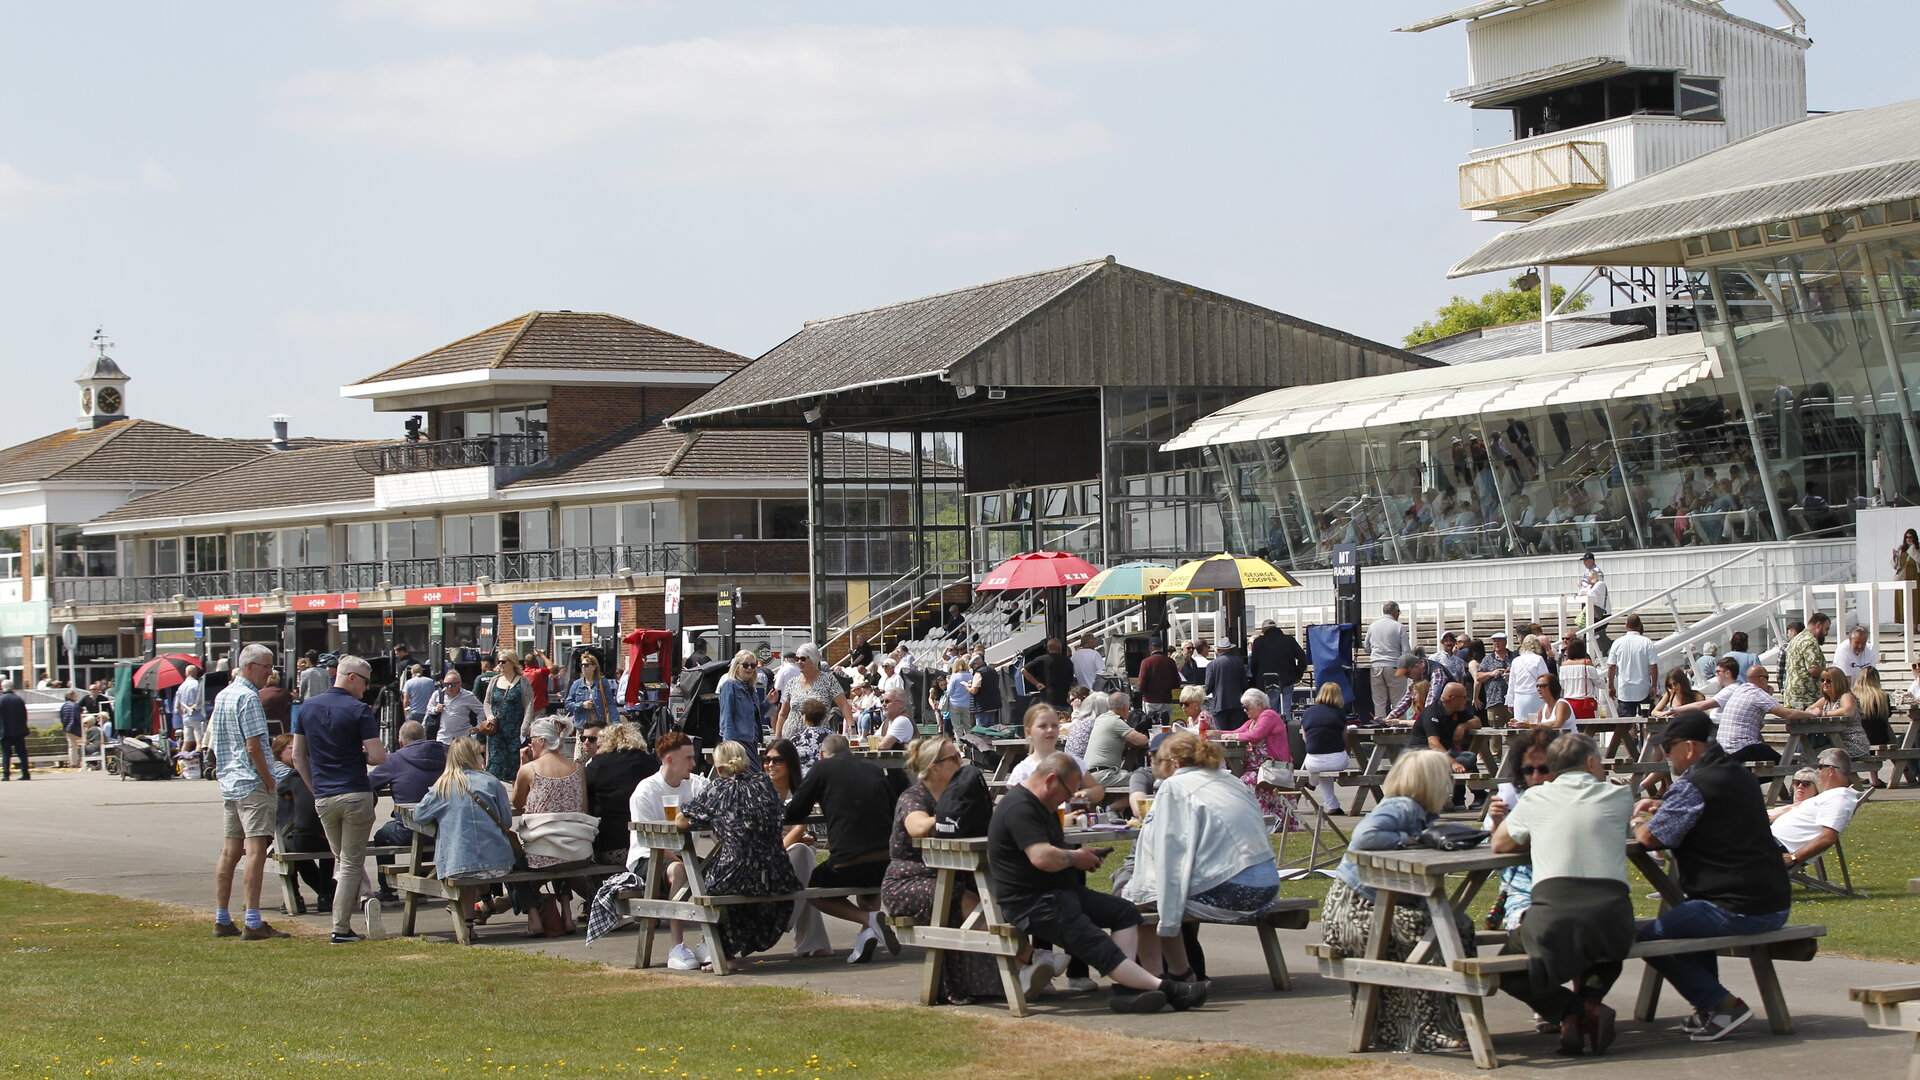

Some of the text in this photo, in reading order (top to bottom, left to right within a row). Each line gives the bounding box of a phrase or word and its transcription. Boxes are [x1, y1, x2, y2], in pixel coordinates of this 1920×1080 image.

[1338, 551, 1350, 564] MT
[1333, 565, 1356, 577] RACING
[423, 592, 442, 602] tote
[308, 599, 326, 608] tote
[551, 606, 566, 620] HILL
[567, 609, 588, 619] Betting
[97, 644, 114, 656] BAR
